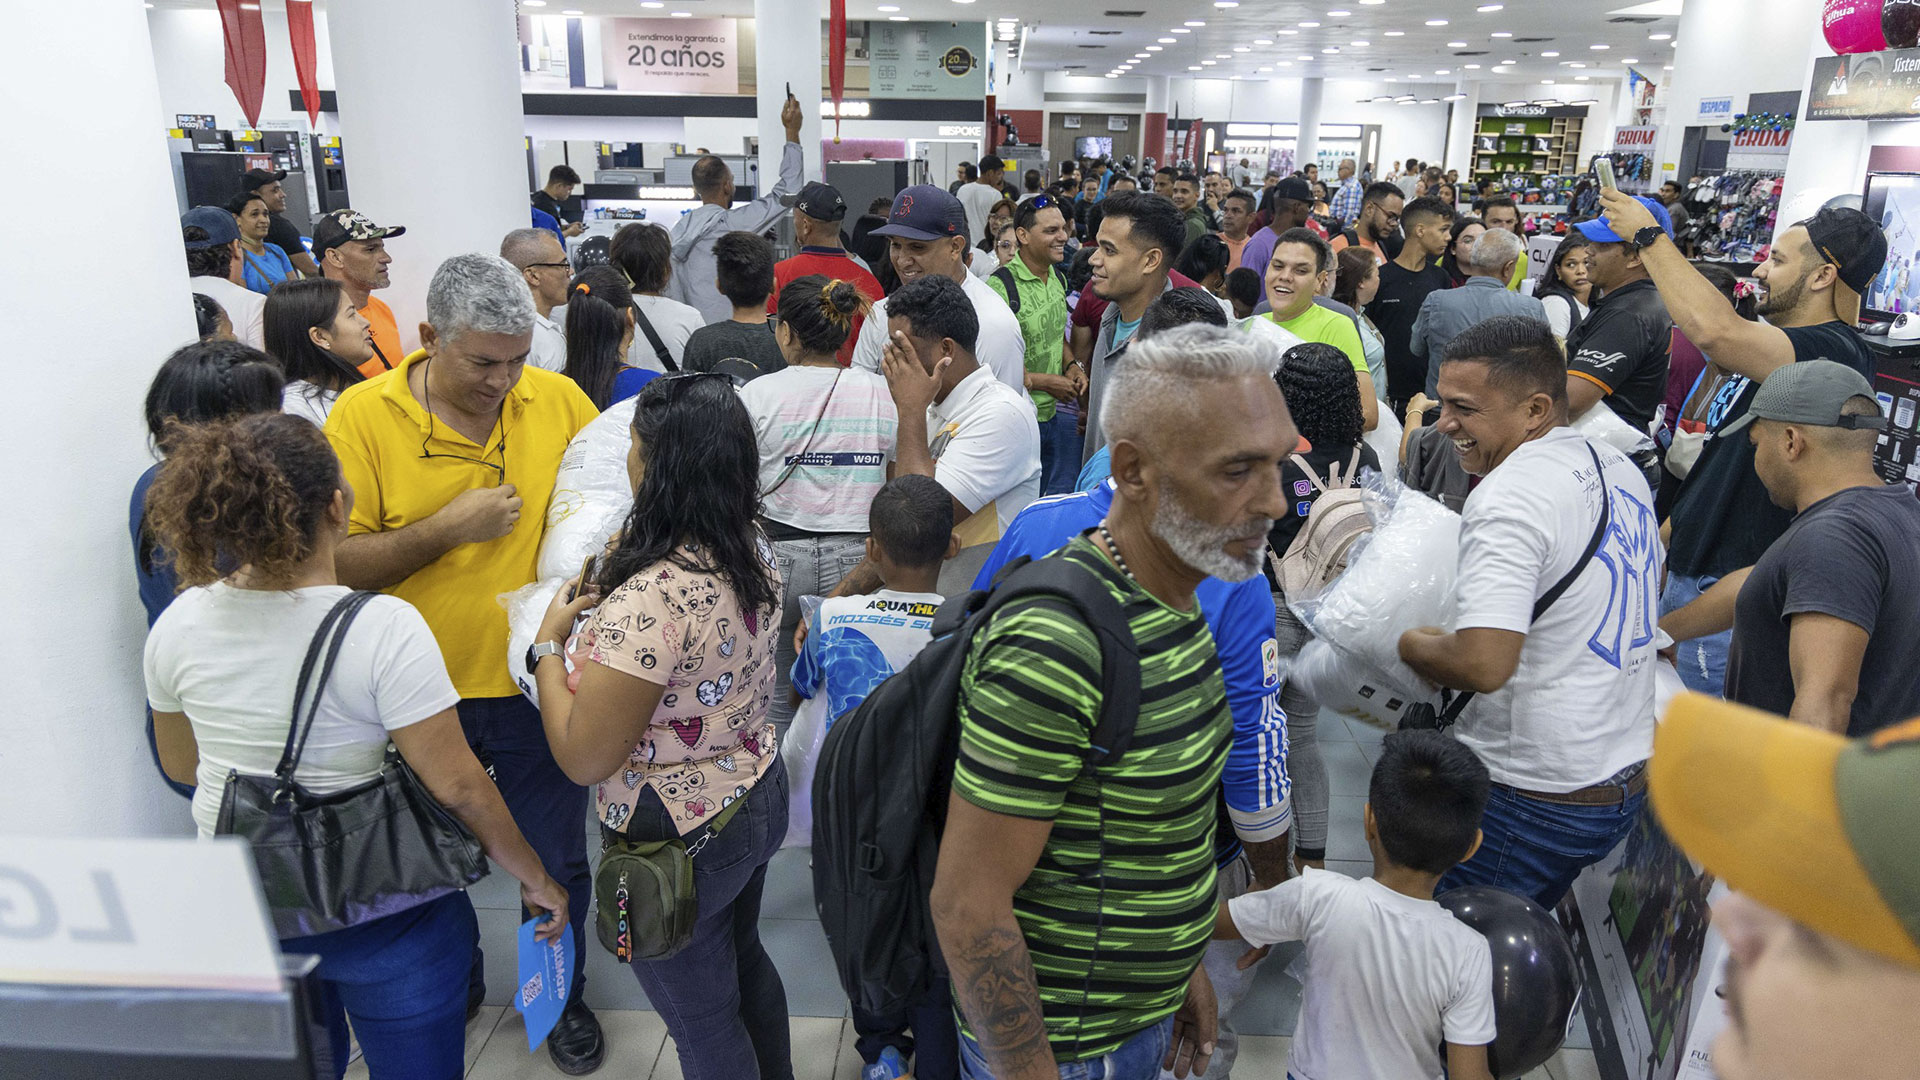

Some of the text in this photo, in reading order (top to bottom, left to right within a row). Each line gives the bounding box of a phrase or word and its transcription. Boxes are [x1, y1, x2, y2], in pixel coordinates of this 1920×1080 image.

[628, 33, 674, 42] Extendimos
[675, 34, 683, 42] la
[627, 45, 725, 68] 20 años
[948, 54, 960, 64] 20
[1700, 100, 1731, 114] DESPACHO
[829, 614, 907, 627] MOISÉS
